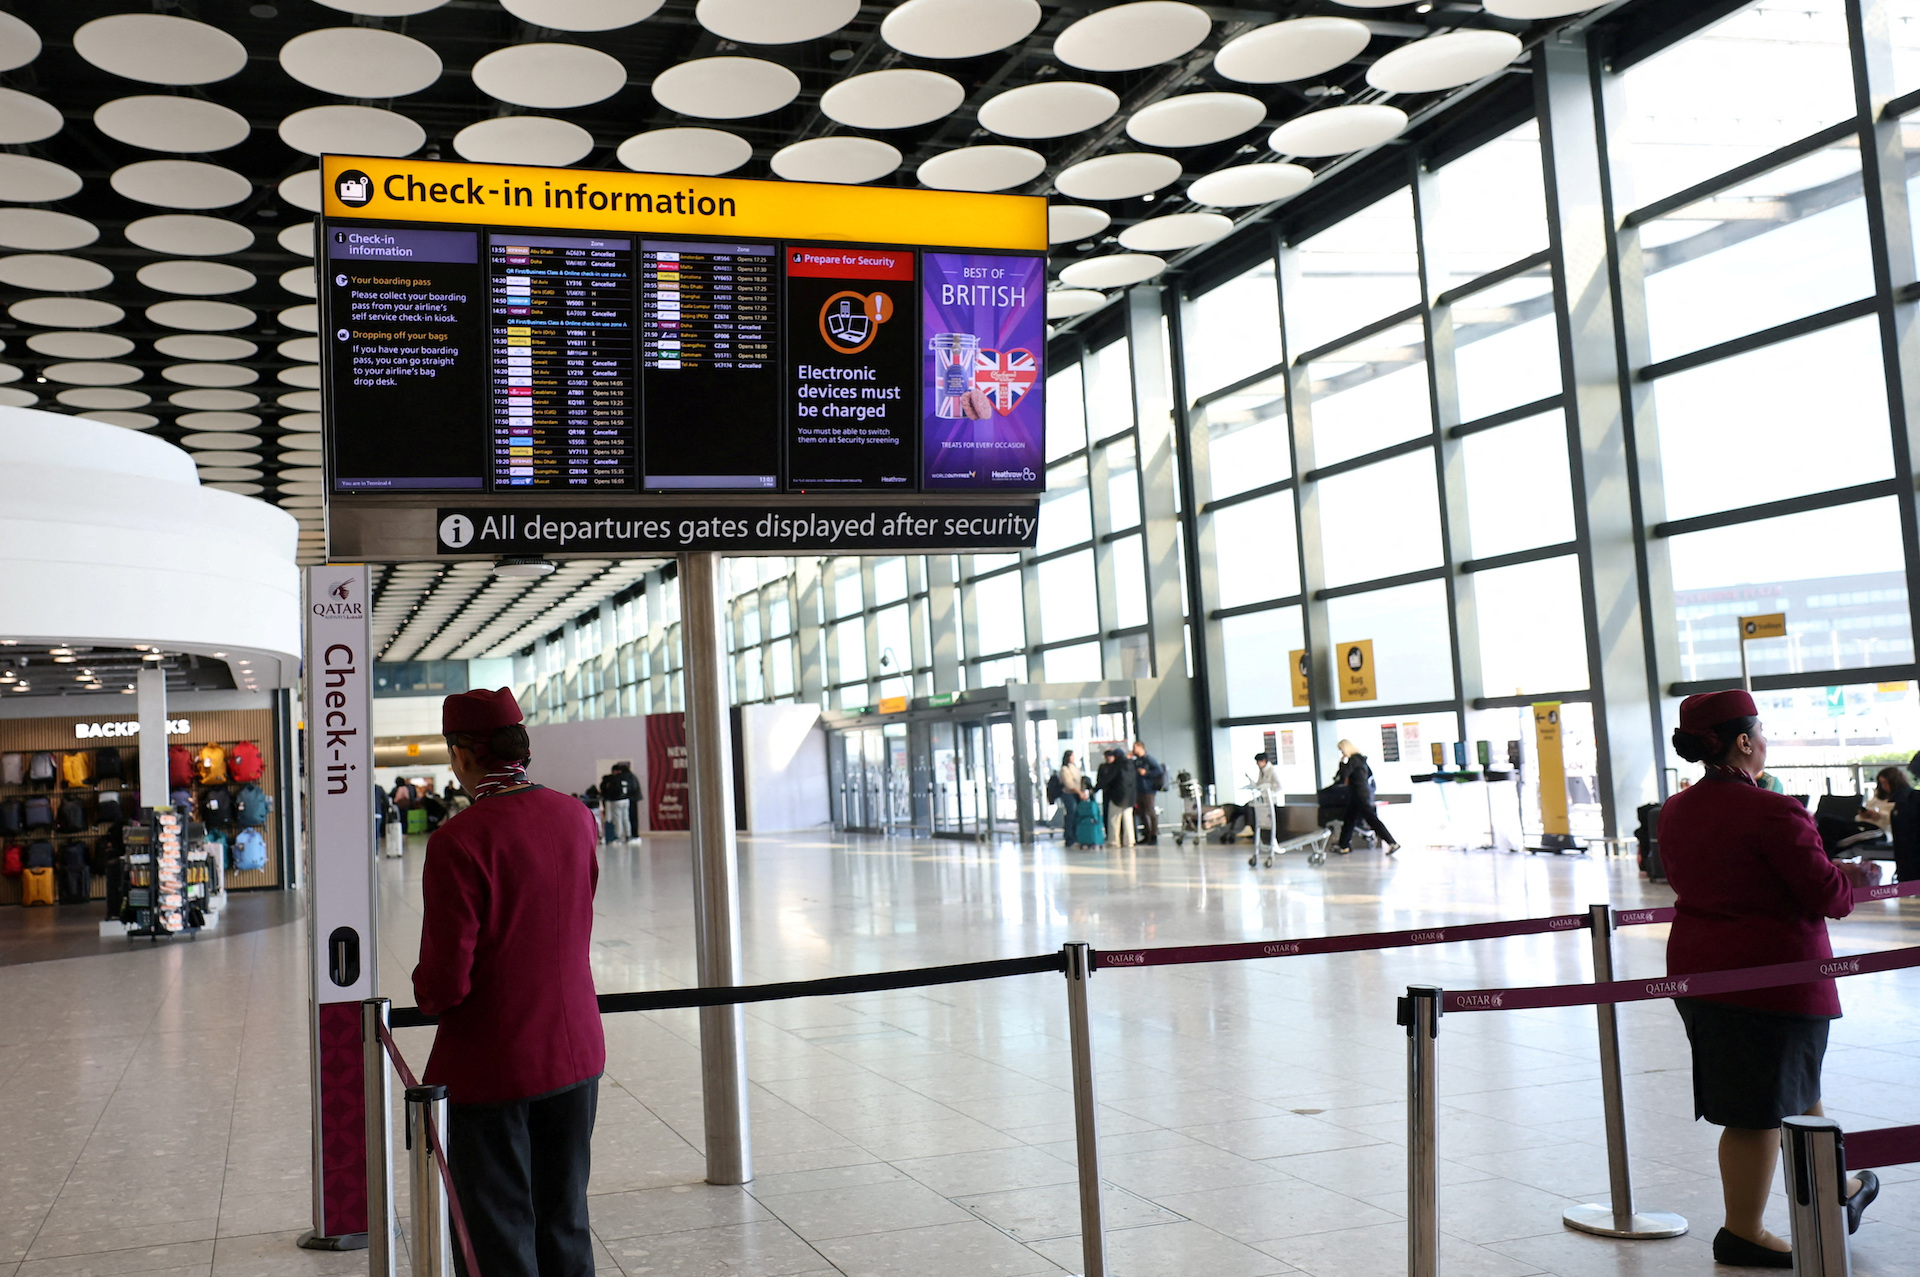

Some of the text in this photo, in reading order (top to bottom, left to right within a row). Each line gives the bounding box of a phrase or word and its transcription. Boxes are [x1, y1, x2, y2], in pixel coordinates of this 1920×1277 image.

[383, 174, 736, 217] Check-in information
[348, 233, 395, 245] Check-in
[349, 245, 413, 256] information
[804, 254, 895, 268] Prepare for Security
[964, 268, 1005, 279] BEST OF
[351, 276, 432, 287] Your boarding pass
[351, 291, 467, 303] Please collect your boarding
[942, 284, 1025, 307] BRITISH
[352, 303, 370, 311] pass
[372, 302, 392, 310] from
[394, 304, 412, 312] your
[352, 312, 458, 322] self service check-in kiosk.
[352, 330, 448, 342] Dropping off your bags
[352, 345, 458, 356] If you have your boarding
[354, 357, 374, 365] pass,
[376, 357, 392, 365] you
[410, 358, 421, 366] go
[422, 356, 454, 367] straight
[354, 367, 363, 375] to
[364, 368, 384, 376] your
[420, 368, 436, 378] bag
[798, 365, 876, 380] Electronic
[354, 378, 374, 386] drop
[798, 384, 900, 400] devices must
[798, 402, 886, 420] be charged
[838, 436, 865, 445] Security
[866, 437, 900, 445] screening
[480, 512, 1036, 546] All departures gates displayed after security
[313, 603, 362, 617] QATAR
[324, 644, 356, 794] Check-in
[75, 719, 190, 738] BACKPKS
[1870, 886, 1891, 898] QATAR
[1622, 912, 1646, 922] QATAR
[1550, 918, 1572, 928] QATAR
[1410, 932, 1436, 942] QATAR
[1264, 944, 1290, 954] QATAR
[1106, 954, 1134, 964] QATAR
[1820, 961, 1849, 976] QATAR
[1646, 980, 1677, 995] QATAR
[1456, 996, 1490, 1006] QATAR
